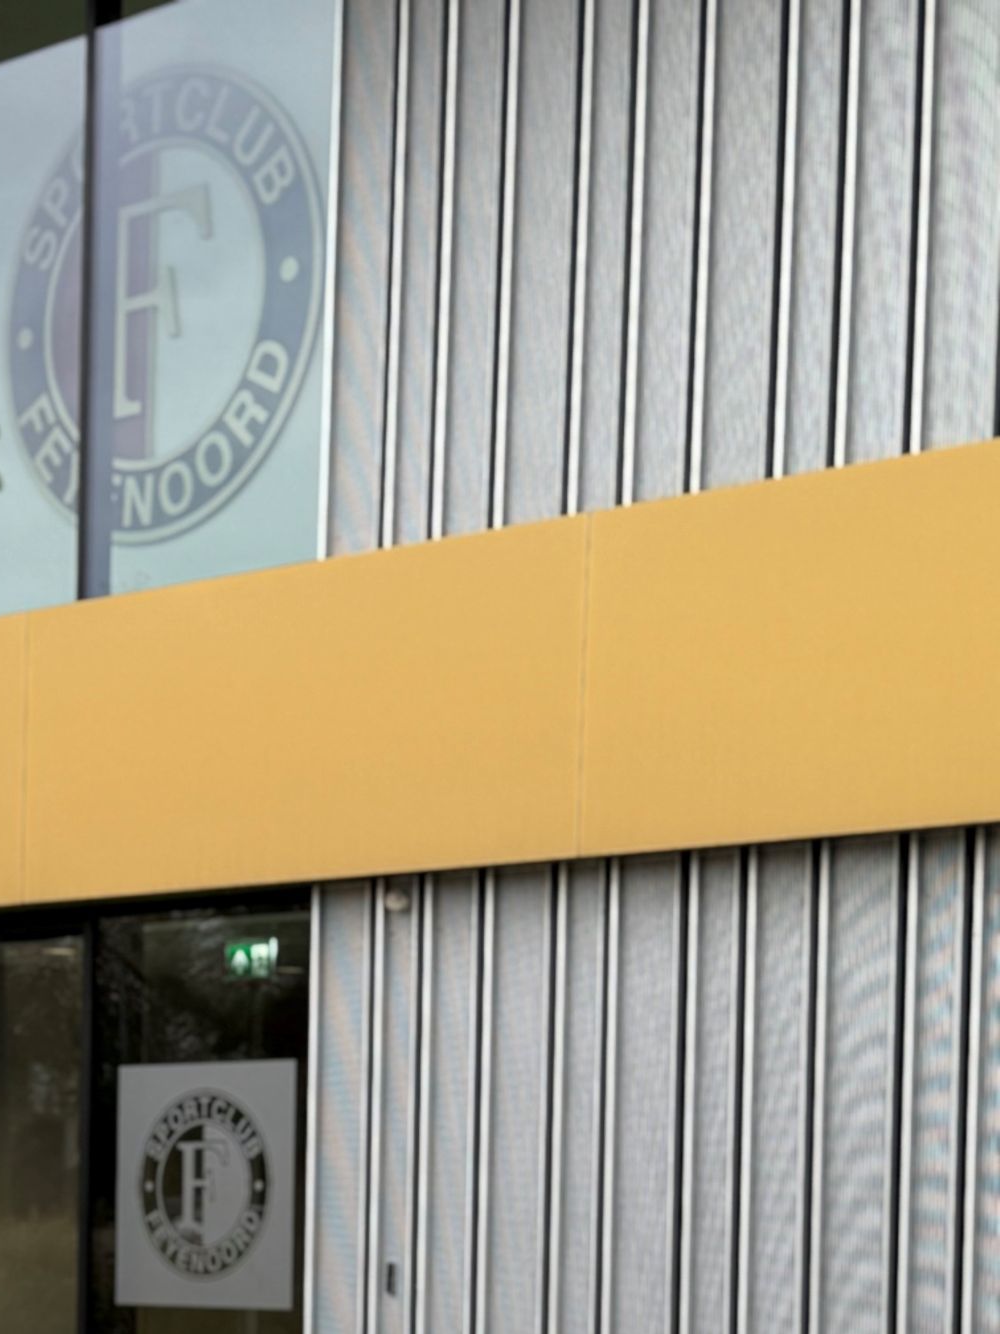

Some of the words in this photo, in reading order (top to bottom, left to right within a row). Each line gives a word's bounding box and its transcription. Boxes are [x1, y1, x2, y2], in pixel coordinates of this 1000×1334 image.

[24, 78, 296, 271] SPRTCLUB
[18, 340, 290, 528] FENOORD
[146, 1095, 263, 1160] SPORTCLUB
[145, 1203, 263, 1274] FEYENOORD
